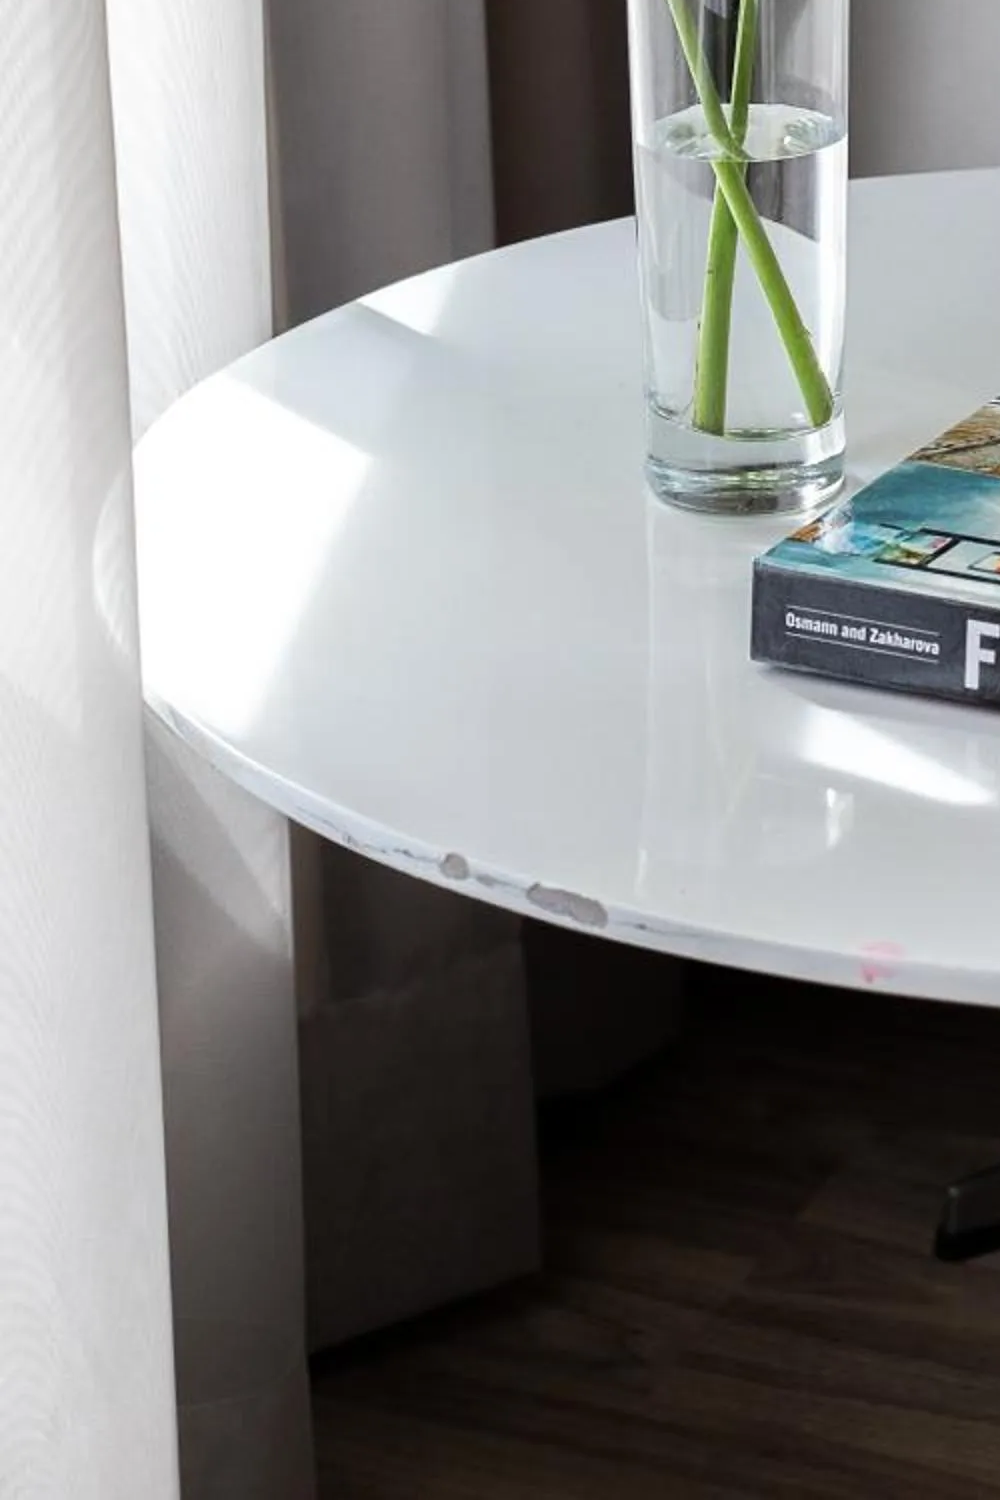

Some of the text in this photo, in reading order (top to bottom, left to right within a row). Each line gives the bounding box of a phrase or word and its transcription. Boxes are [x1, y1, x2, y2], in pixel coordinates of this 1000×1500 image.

[785, 611, 940, 655] Osmann and Zakharova
